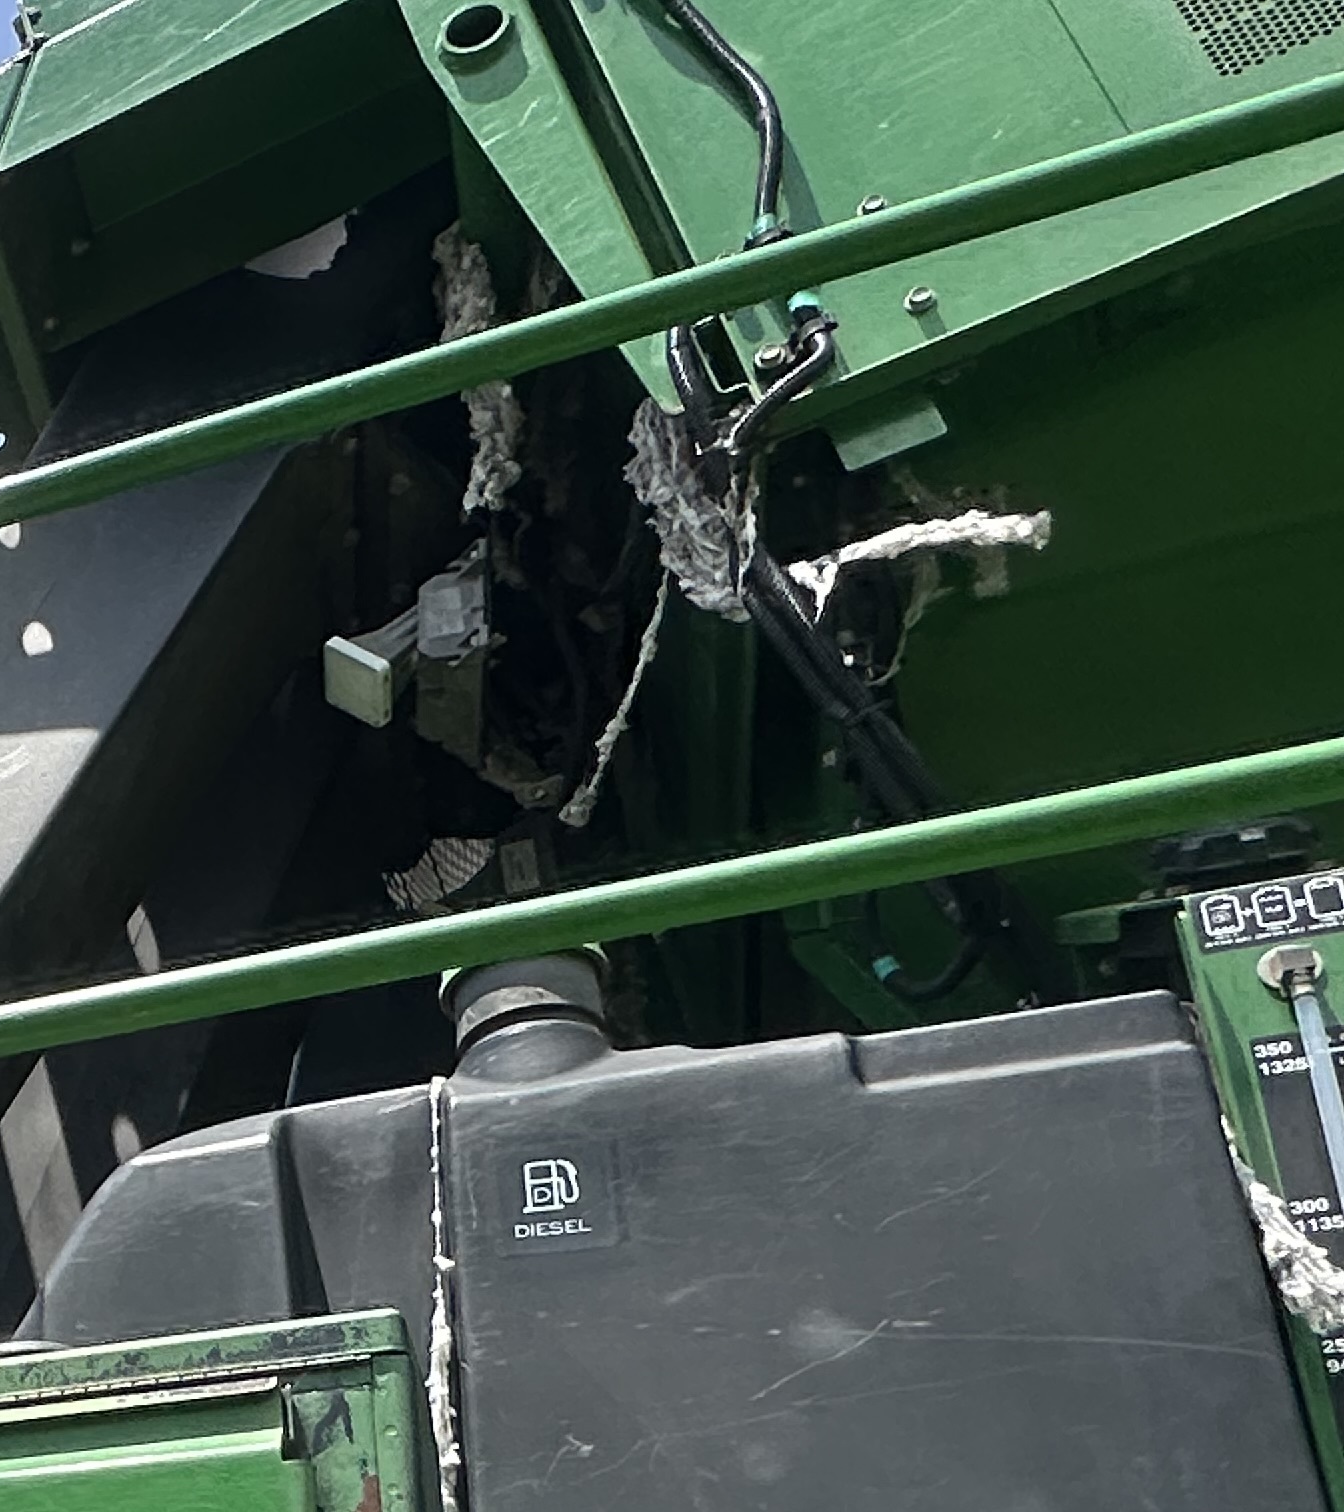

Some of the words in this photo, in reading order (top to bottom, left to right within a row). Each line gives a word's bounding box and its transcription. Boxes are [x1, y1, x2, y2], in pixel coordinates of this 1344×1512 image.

[1253, 1041, 1292, 1058] 350
[1289, 1197, 1330, 1215] 300
[514, 1218, 592, 1238] DIESEL
